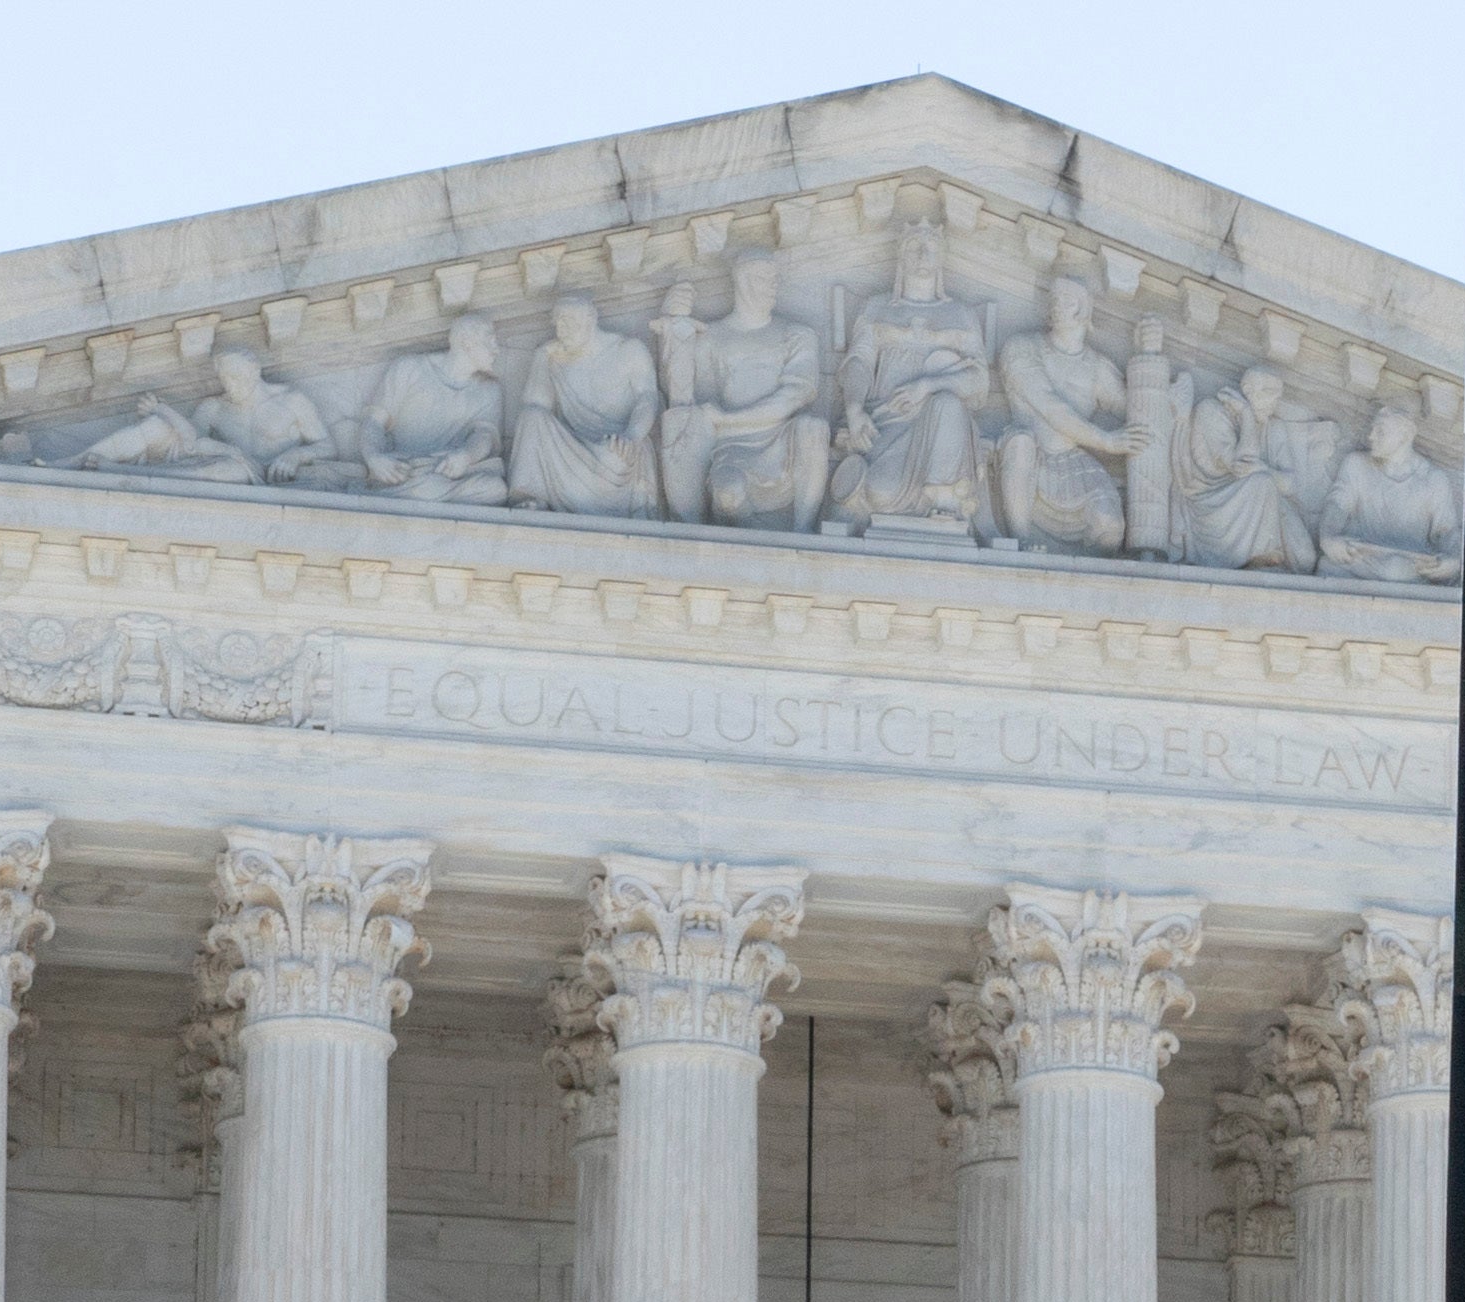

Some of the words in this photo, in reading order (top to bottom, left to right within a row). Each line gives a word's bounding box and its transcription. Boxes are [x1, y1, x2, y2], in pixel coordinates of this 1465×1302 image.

[384, 666, 643, 735] EQUAL
[663, 685, 957, 760] JUSTICE
[998, 709, 1243, 779] UNDER
[1271, 733, 1413, 792] LAW
